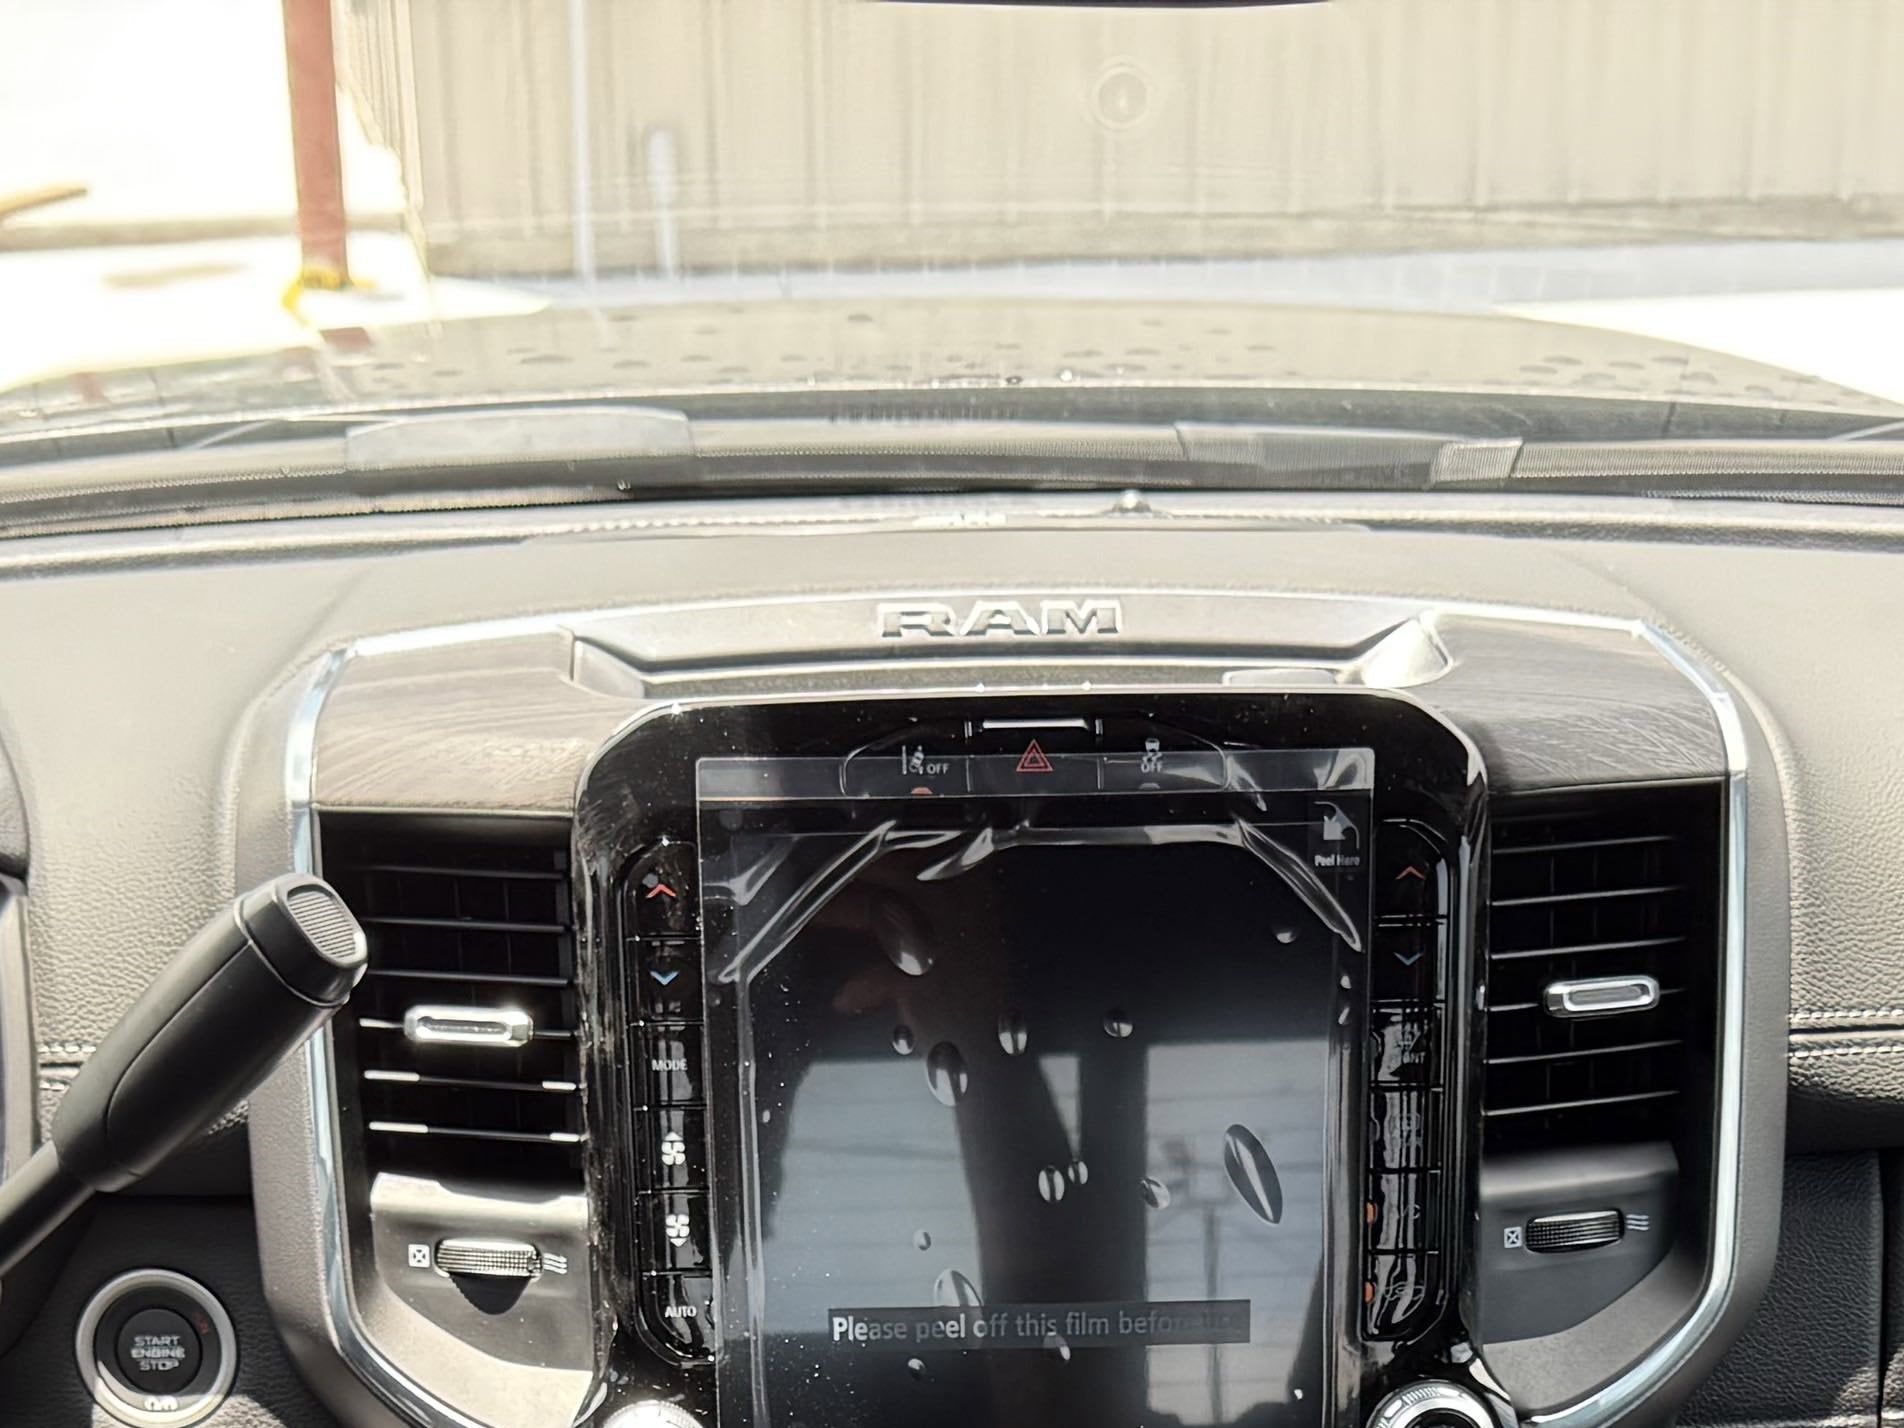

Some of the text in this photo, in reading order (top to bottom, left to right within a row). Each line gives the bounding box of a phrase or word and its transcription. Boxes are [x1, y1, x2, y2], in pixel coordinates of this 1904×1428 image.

[878, 599, 1123, 638] RAM
[926, 762, 949, 775] OFF
[1140, 762, 1164, 774] OFF
[1314, 853, 1335, 867] Peel
[651, 1059, 688, 1072] MODE
[664, 1305, 697, 1318] AUTO
[832, 1315, 907, 1342] Please
[915, 1313, 966, 1343] peel
[972, 1312, 1011, 1339] off
[1015, 1312, 1057, 1338] this
[1065, 1311, 1110, 1337] film
[1119, 1309, 1198, 1334] befor
[133, 1335, 181, 1348] START
[130, 1347, 186, 1359] ENGINE
[139, 1359, 180, 1371] STOP
